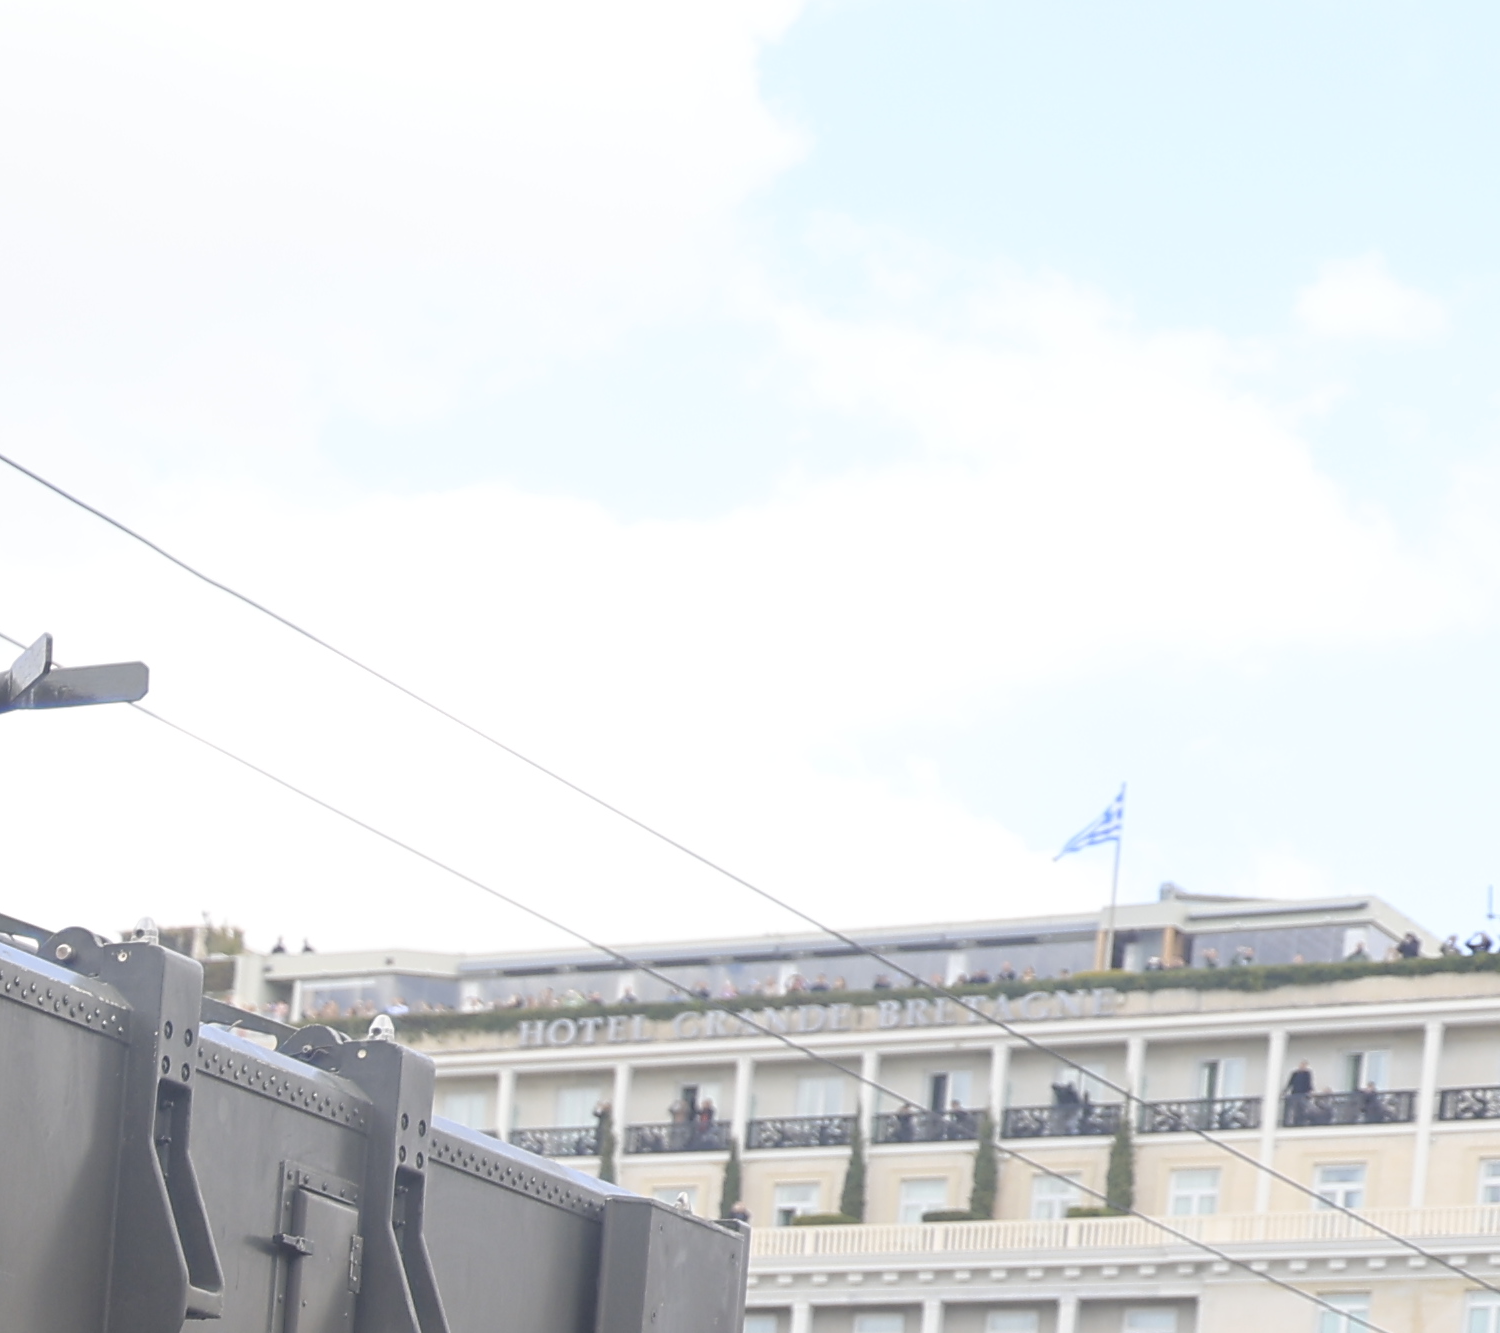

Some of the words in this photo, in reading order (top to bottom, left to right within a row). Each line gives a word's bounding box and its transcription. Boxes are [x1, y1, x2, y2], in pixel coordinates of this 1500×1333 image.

[518, 1014, 650, 1047] HOTEL
[672, 1001, 851, 1039] GRANDE
[877, 986, 1117, 1028] BRETAGNE
